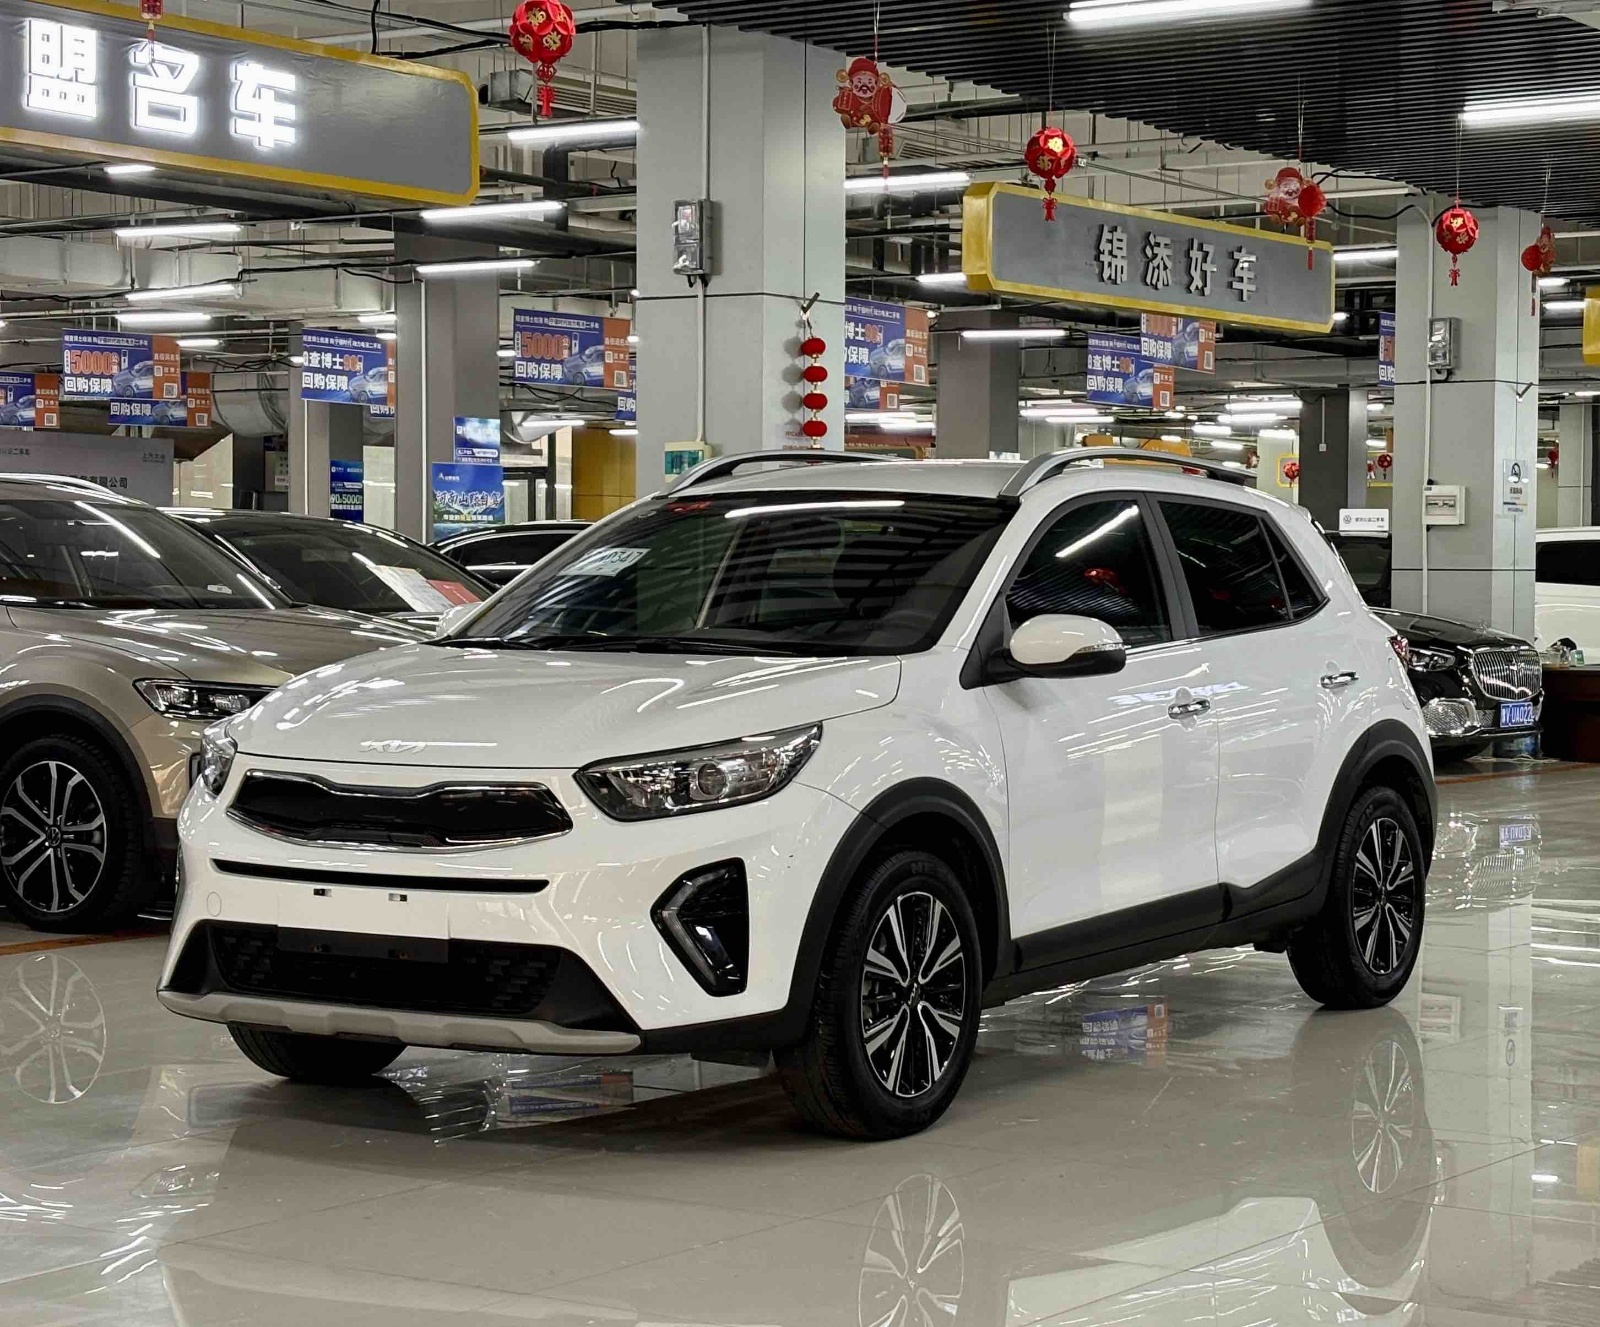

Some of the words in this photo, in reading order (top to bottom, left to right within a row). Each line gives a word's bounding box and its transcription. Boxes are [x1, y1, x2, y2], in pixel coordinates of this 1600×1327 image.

[26, 18, 297, 149] 盟名车
[1098, 225, 1257, 301] 锦添好车
[845, 346, 869, 365] 保障
[1141, 337, 1172, 360] 回购保障
[515, 361, 562, 380] 回购保障
[64, 377, 112, 394] 回购保障
[302, 372, 348, 391] 回购保障
[1086, 375, 1123, 393] 回购保障
[110, 402, 151, 416] 回购保障
[617, 396, 636, 411] 回购
